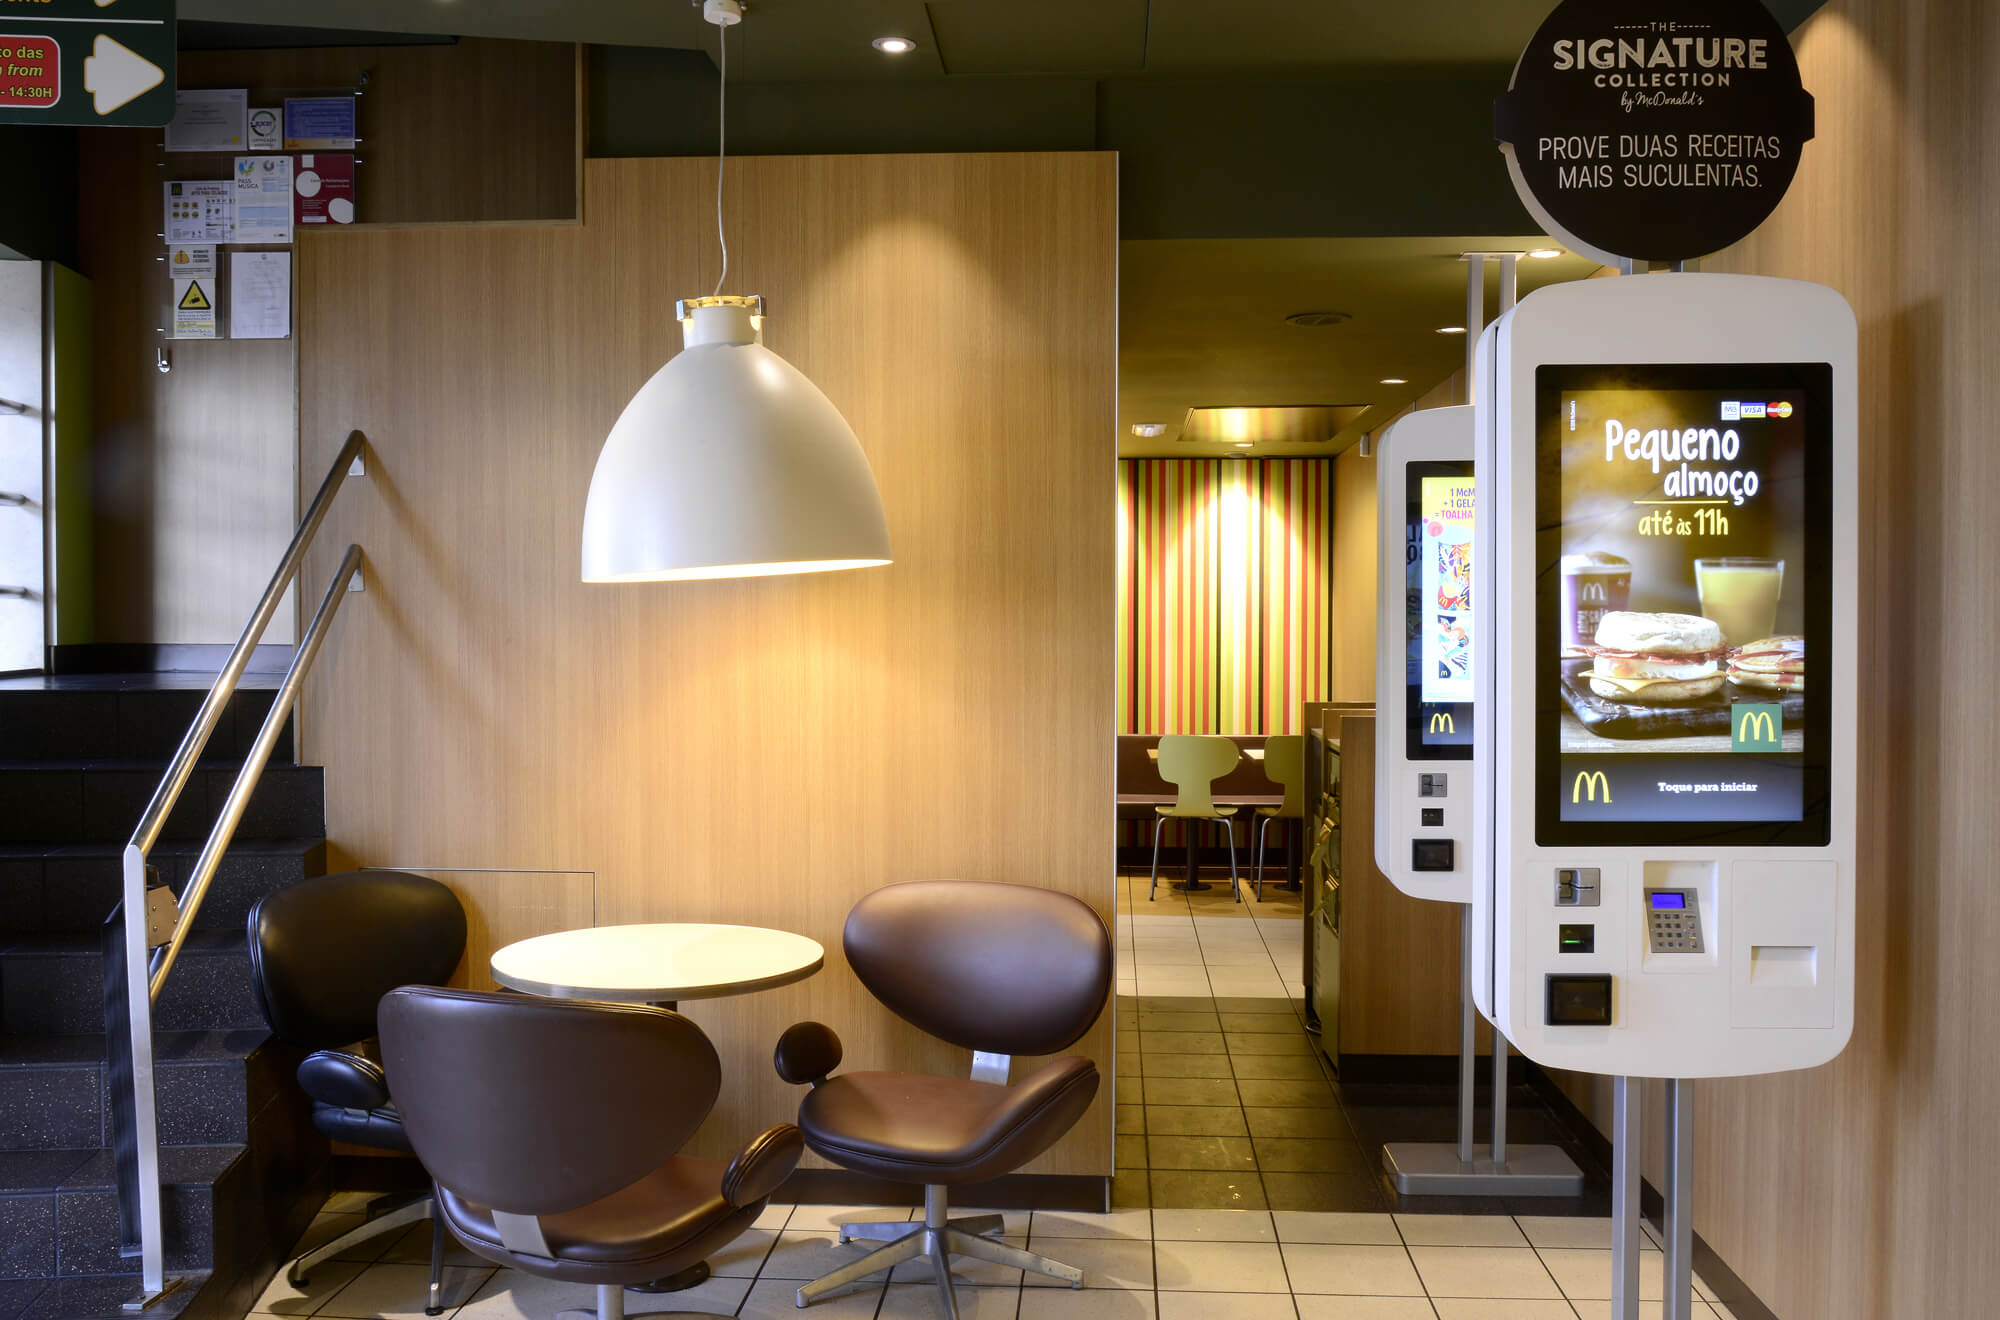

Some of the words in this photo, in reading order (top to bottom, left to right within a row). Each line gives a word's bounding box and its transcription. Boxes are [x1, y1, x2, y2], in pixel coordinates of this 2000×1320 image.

[1650, 22, 1676, 32] THE
[16, 46, 44, 59] das
[1553, 37, 1768, 70] SIGNATURE
[7, 63, 43, 77] from
[1594, 72, 1730, 88] COLLECTION
[9, 86, 52, 98] 14:30H
[1620, 91, 1634, 113] by
[1635, 90, 1704, 107] McDonald's
[1539, 135, 1609, 161] PROVE
[1619, 134, 1678, 158] DUAS
[1688, 134, 1780, 159] RECEITAS
[1559, 164, 1613, 189] MAIS
[1623, 163, 1762, 188] SUCULENTAS.
[1605, 418, 1740, 474] Pequeno
[1663, 462, 1759, 506] almoço
[1440, 509, 1473, 520] TOALHA
[1638, 509, 1673, 536] até
[1676, 518, 1692, 536] às
[1693, 508, 1729, 536] 11h
[1657, 781, 1692, 794] Toque
[1693, 783, 1720, 794] para
[1720, 782, 1759, 792] iniciar
